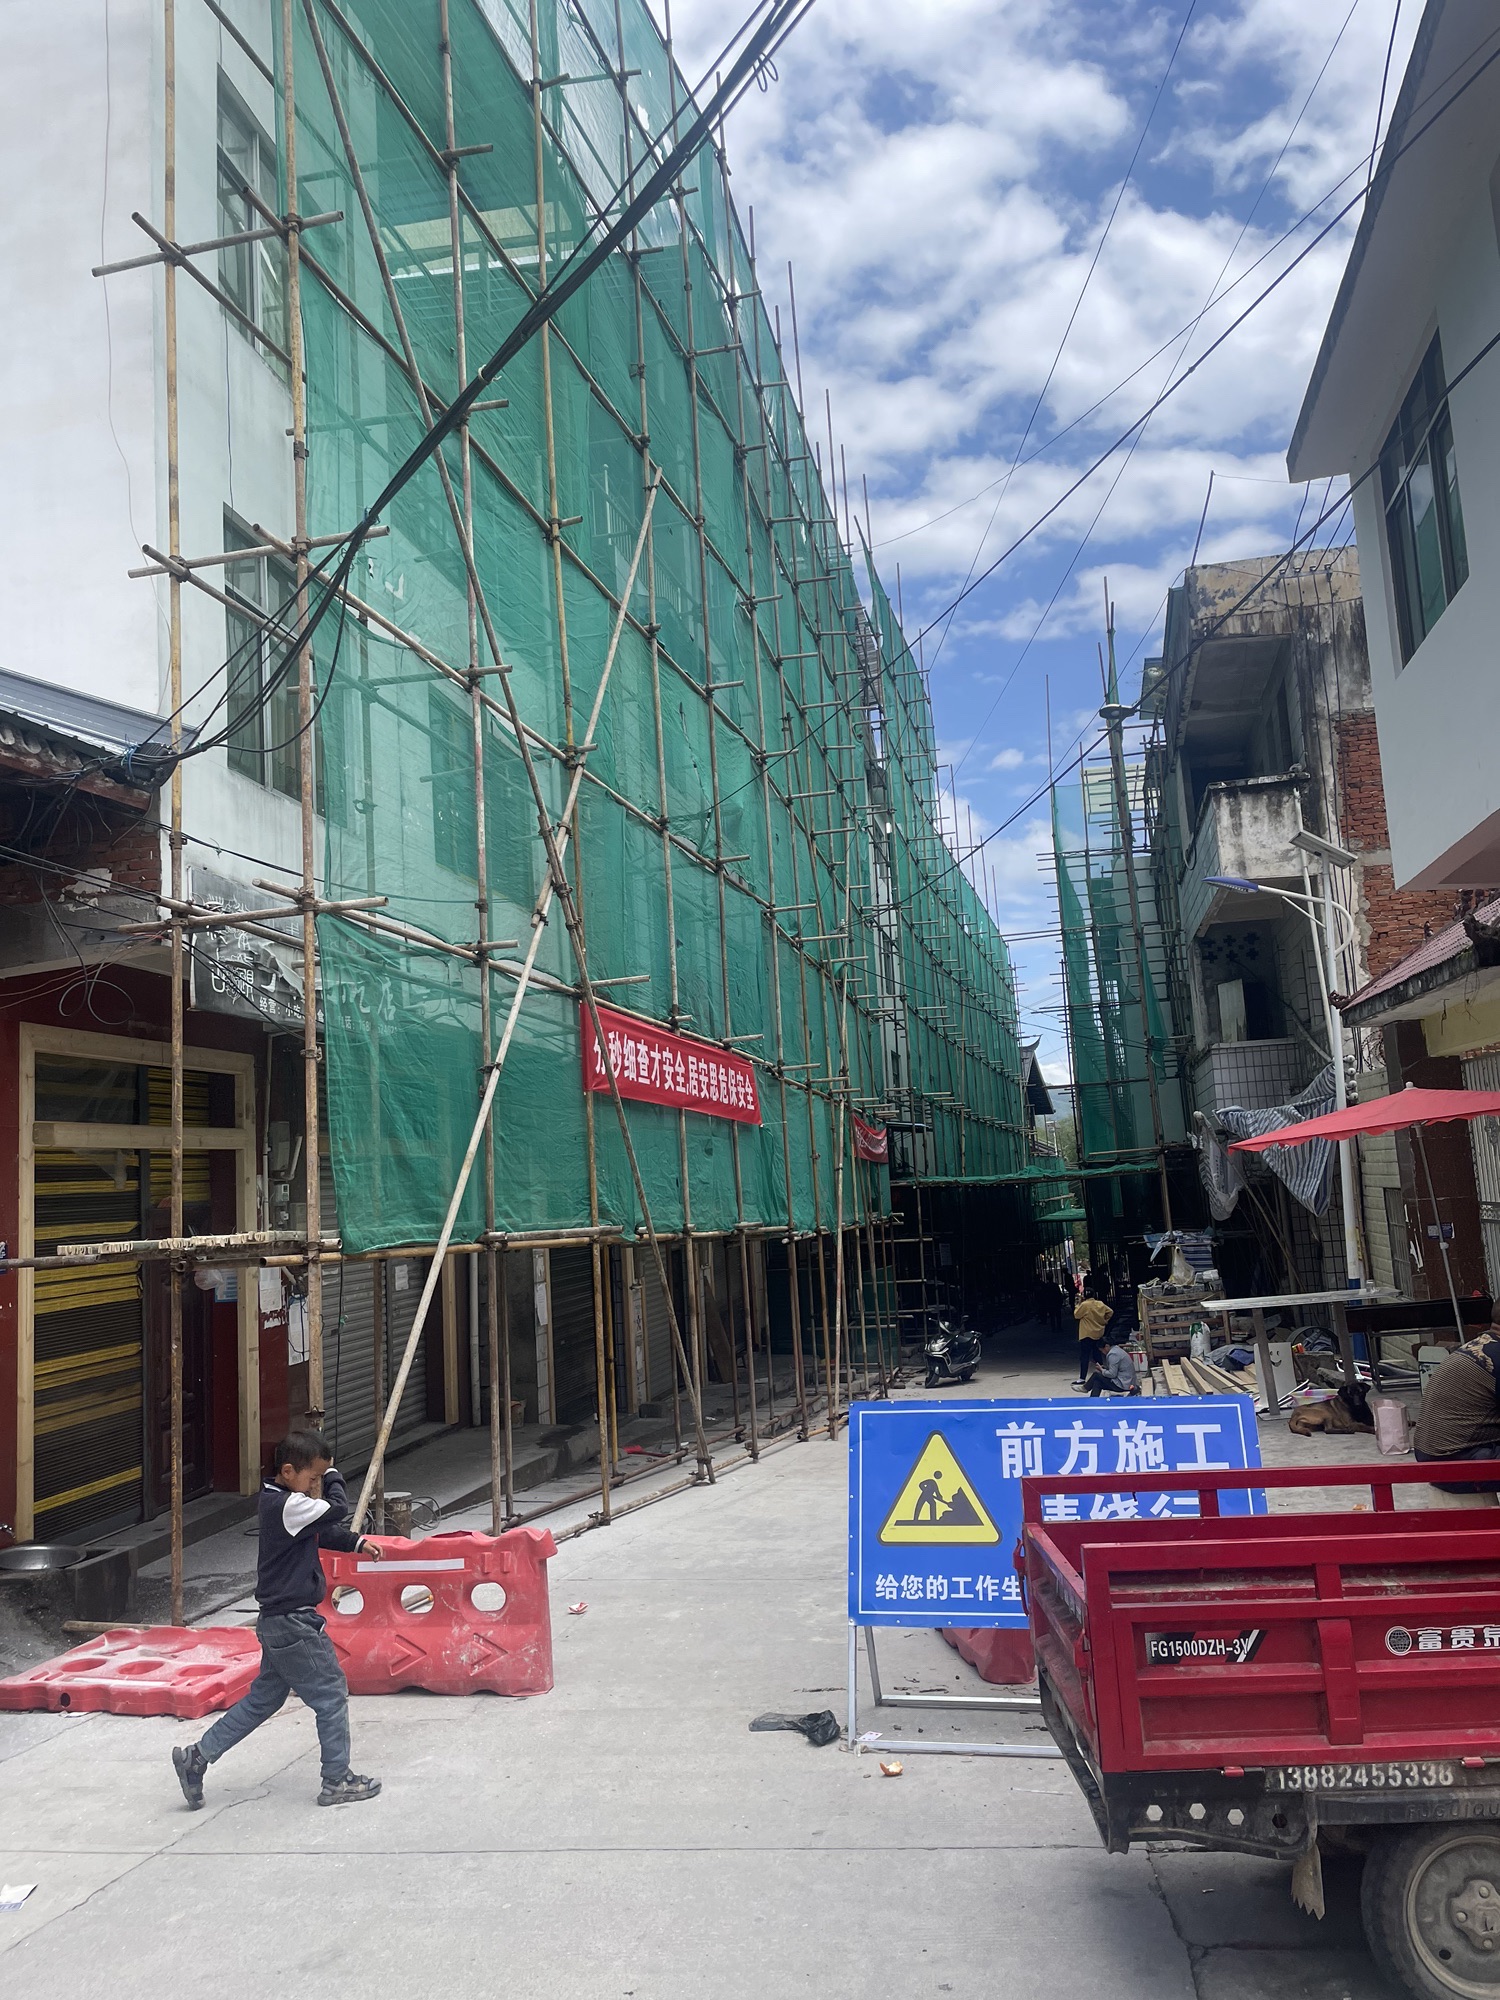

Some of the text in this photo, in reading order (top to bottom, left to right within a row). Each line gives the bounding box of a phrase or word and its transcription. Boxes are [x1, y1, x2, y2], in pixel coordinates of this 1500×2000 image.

[996, 1420, 1230, 1479] 前方施工
[875, 1573, 1022, 1601] 给您的工作生
